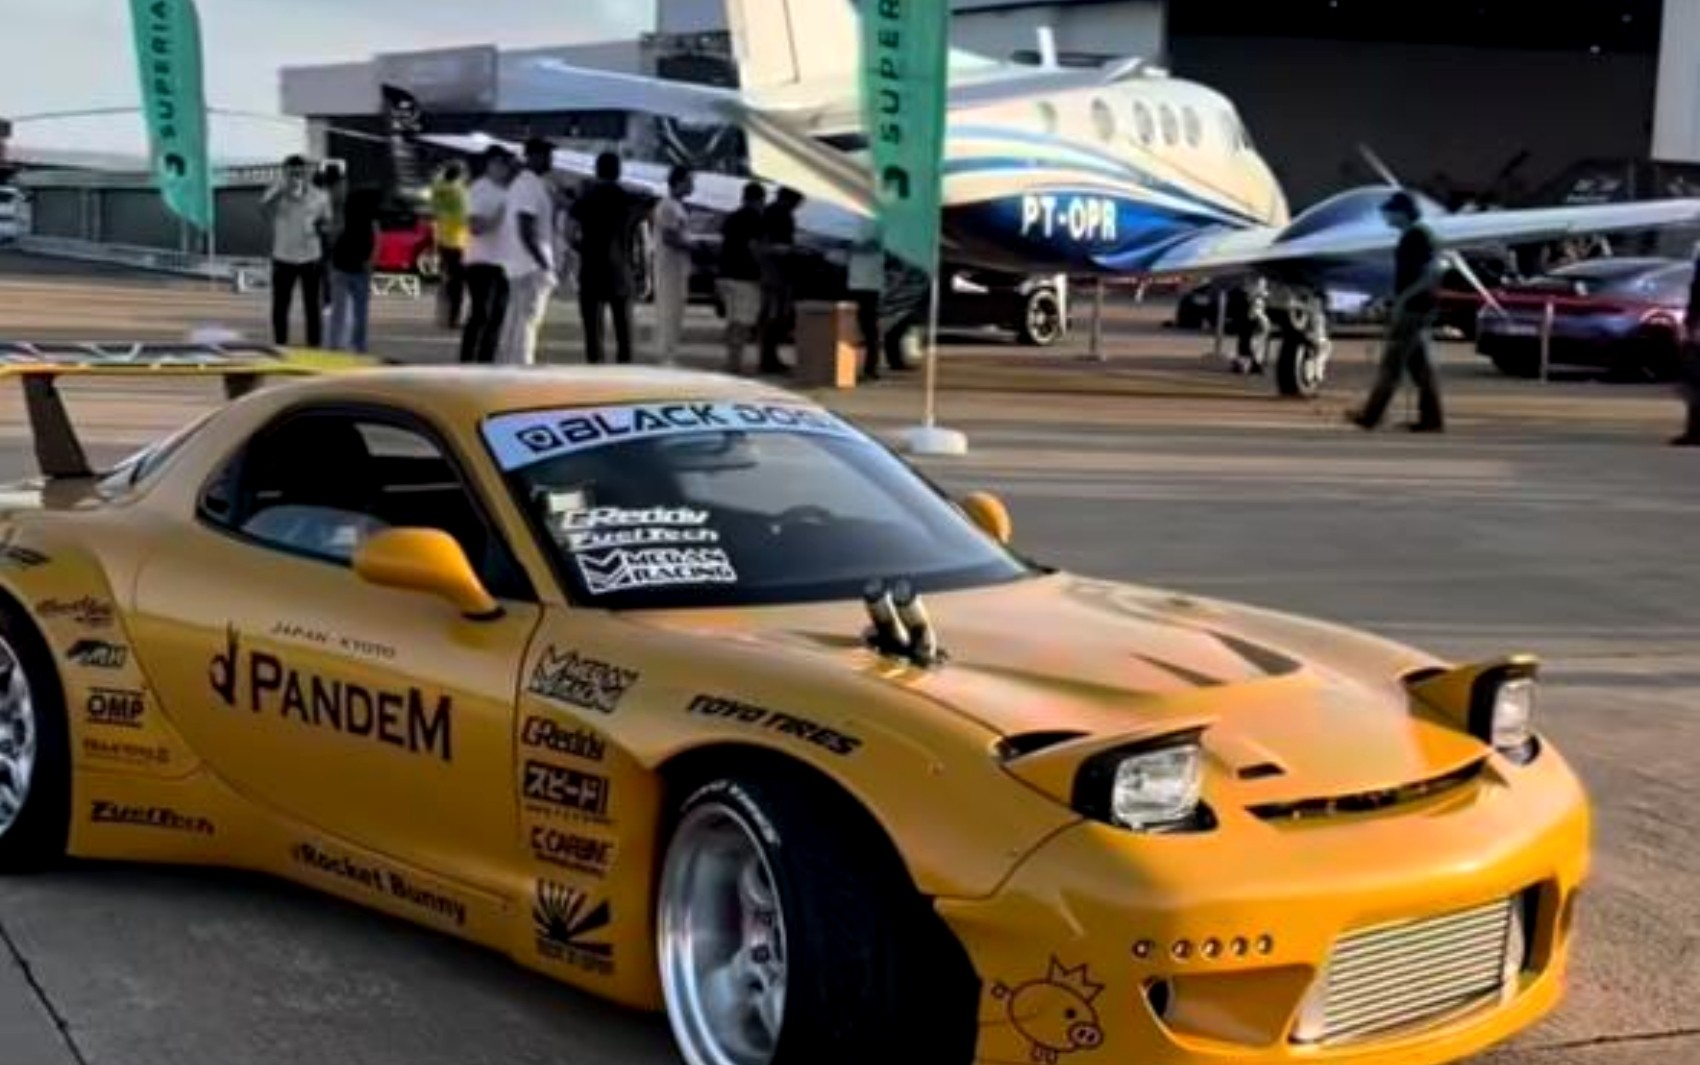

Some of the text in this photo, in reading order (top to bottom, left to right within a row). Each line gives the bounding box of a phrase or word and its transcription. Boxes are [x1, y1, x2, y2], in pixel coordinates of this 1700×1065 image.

[1020, 195, 1117, 241] PT-OPR
[558, 405, 728, 443] BLACK
[87, 695, 144, 720] OMP
[250, 651, 454, 762] PANDEM
[527, 766, 600, 807] スピード
